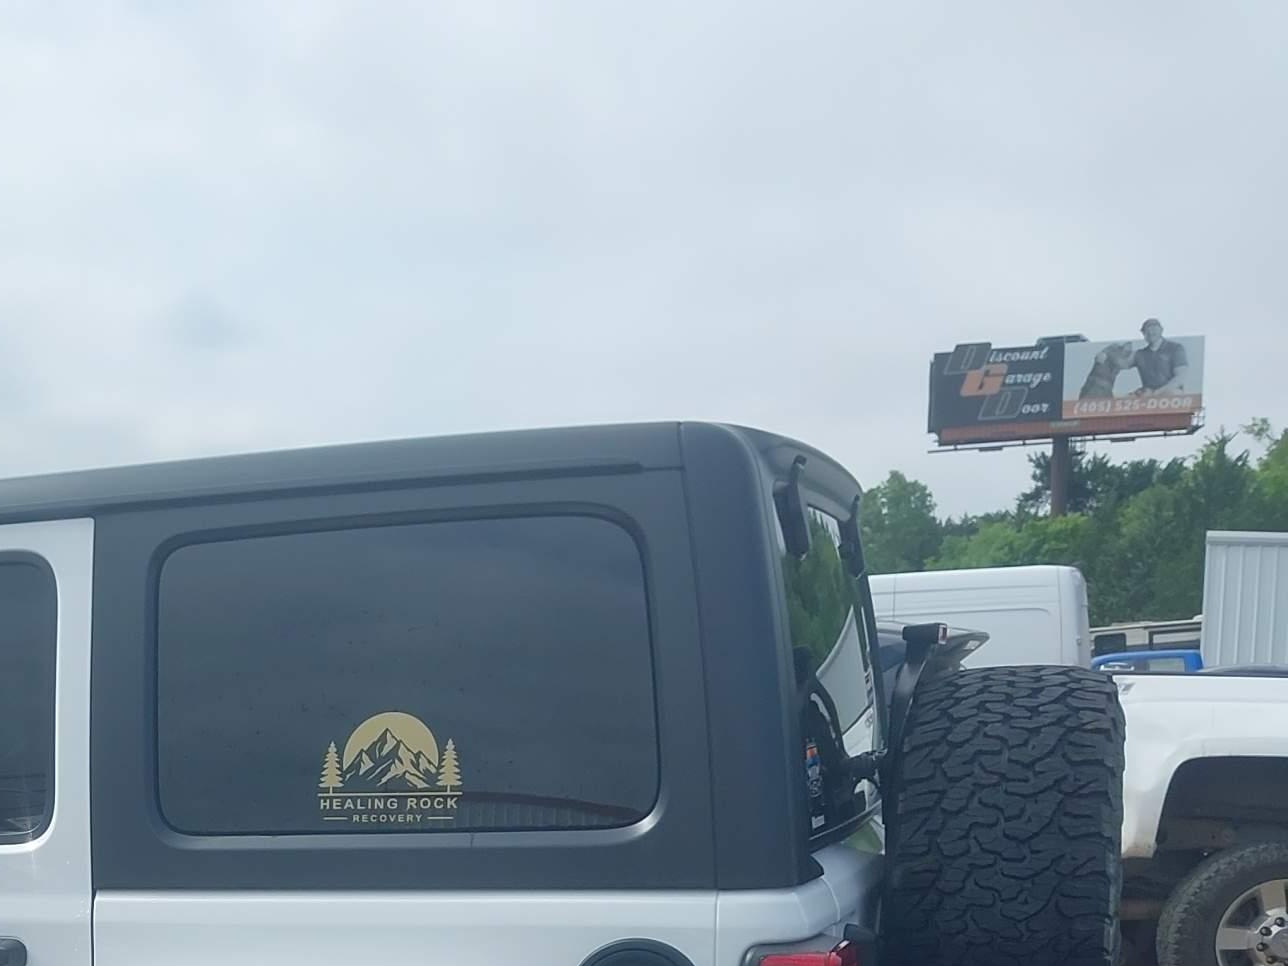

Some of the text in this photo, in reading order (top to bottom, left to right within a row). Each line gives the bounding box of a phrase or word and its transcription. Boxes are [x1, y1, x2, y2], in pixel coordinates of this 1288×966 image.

[943, 342, 1049, 375] Discount
[959, 363, 1052, 397] Garage
[977, 386, 1050, 420] Door
[319, 797, 459, 811] HEALING ROCK
[352, 814, 423, 823] RECOVERY
